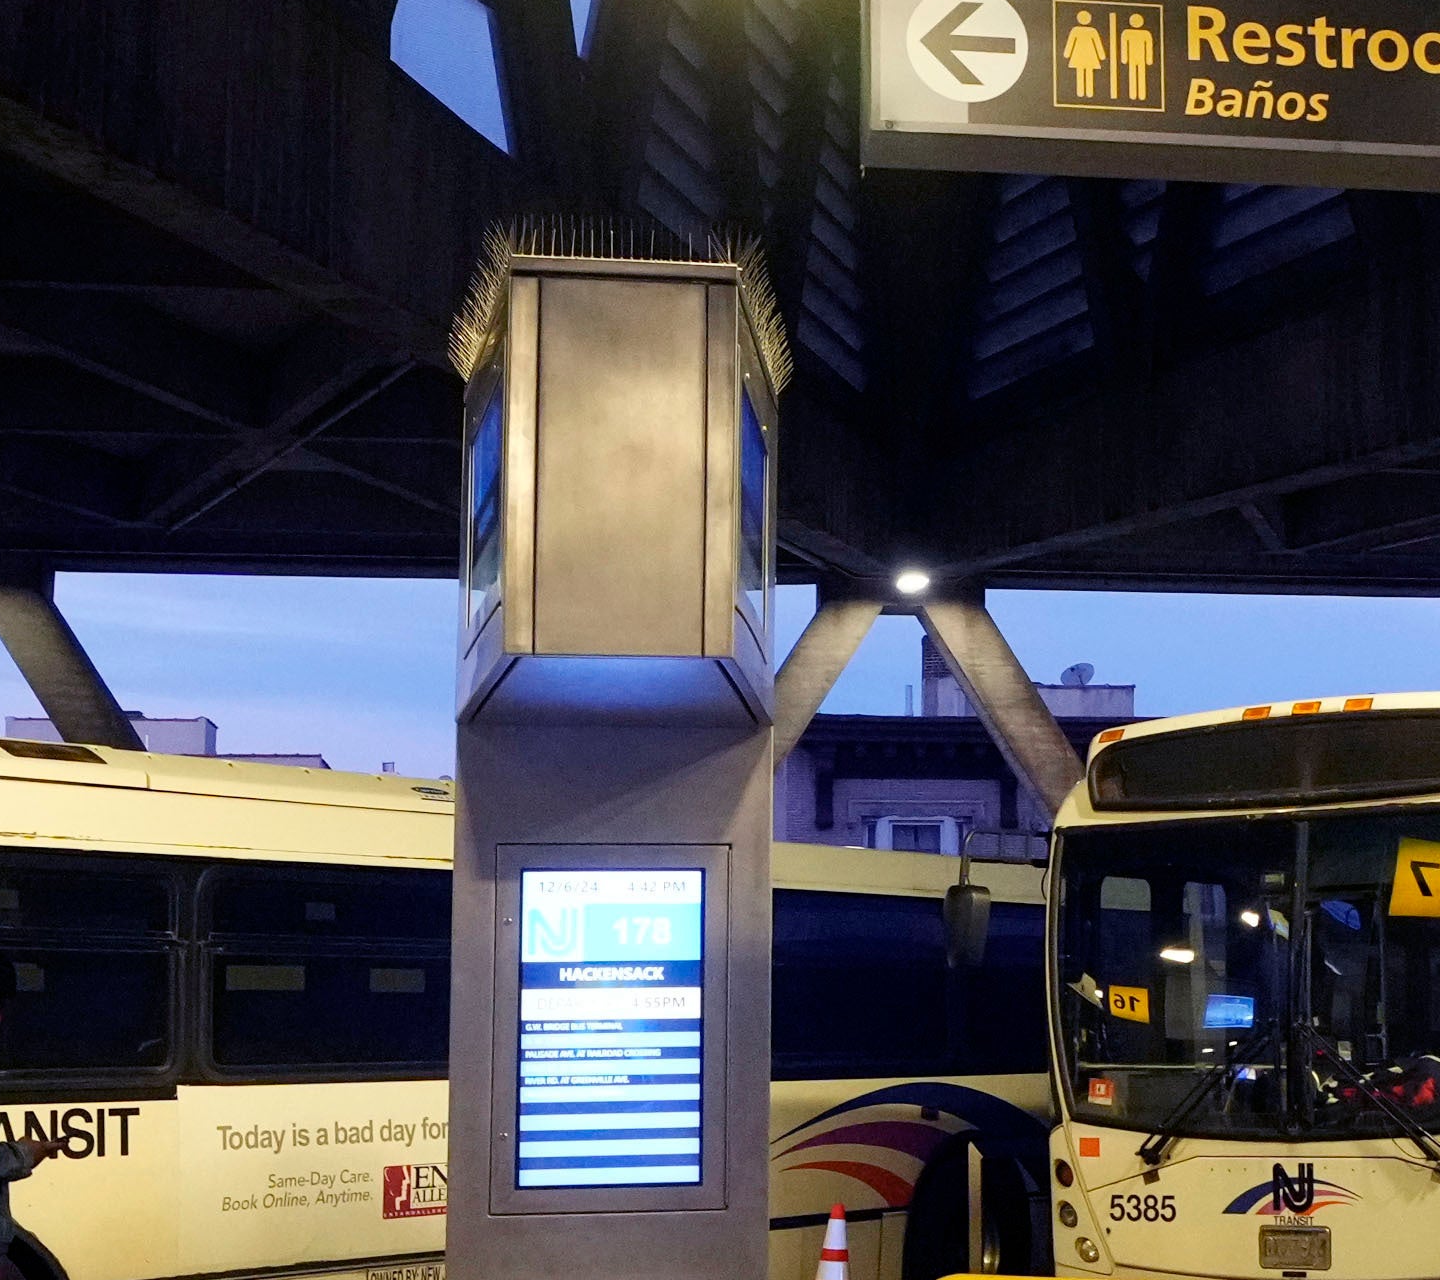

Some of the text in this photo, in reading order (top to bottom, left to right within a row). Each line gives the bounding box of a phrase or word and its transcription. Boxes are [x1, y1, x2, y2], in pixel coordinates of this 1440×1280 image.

[1184, 76, 1331, 124] Baños
[627, 881, 657, 892] 442
[663, 881, 686, 892] PM
[612, 917, 672, 945] 178
[559, 966, 665, 982] HACKENSACK
[632, 996, 686, 1009] 455PM
[216, 1116, 449, 1154] Today is a bad day for
[267, 1168, 374, 1191] Same-Day Care.
[1272, 1162, 1314, 1214] NJ
[221, 1187, 374, 1213] Book Online, Anytime.
[1109, 1194, 1177, 1223] 5385
[1273, 1215, 1315, 1226] TRANSIT
